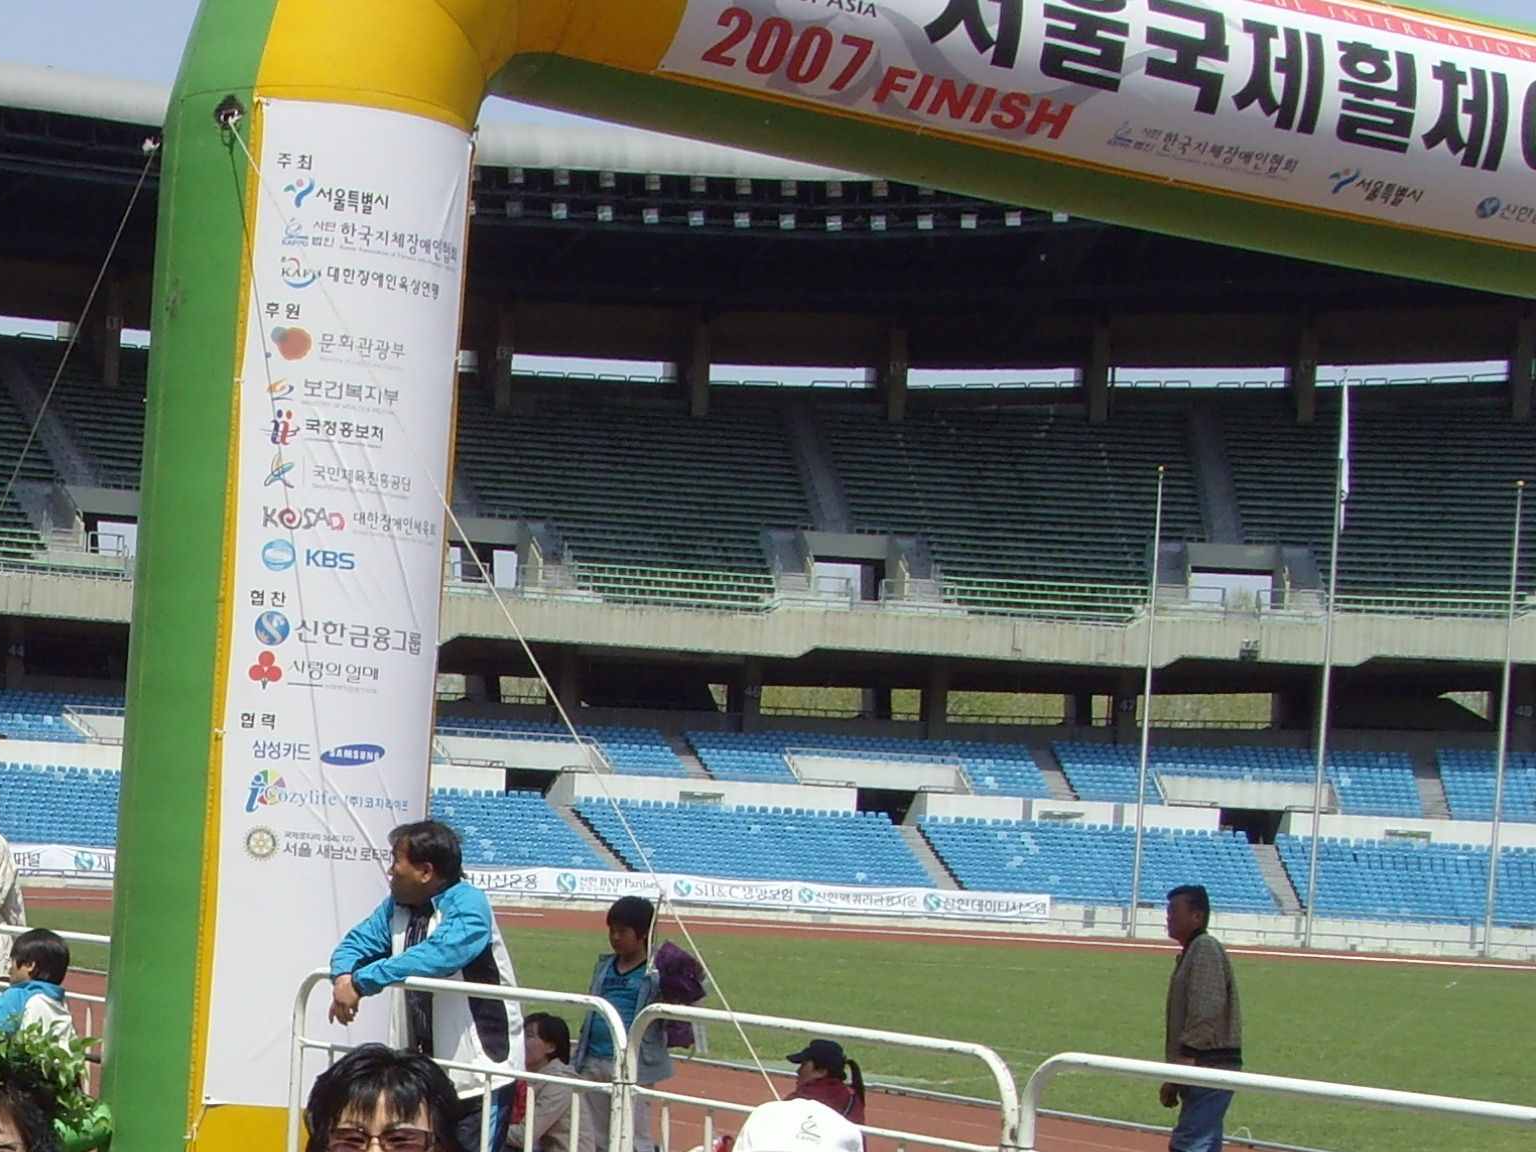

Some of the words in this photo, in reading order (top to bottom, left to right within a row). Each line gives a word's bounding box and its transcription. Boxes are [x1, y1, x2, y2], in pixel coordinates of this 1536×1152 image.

[701, 7, 874, 92] 2007
[873, 65, 1076, 141] FINISH
[315, 186, 390, 215] 서울특별시
[1355, 177, 1426, 208] 서울특별시
[317, 332, 406, 360] 문화관광부
[303, 378, 400, 407] 보건복지부
[305, 418, 384, 442] 국정홍보처
[312, 464, 412, 492] 국민체육진흥공단
[305, 549, 356, 570] KBS
[294, 618, 422, 656] 신한금융그룹
[251, 739, 312, 762] 삼성카드
[328, 748, 380, 762] SAMSUNG
[283, 841, 313, 858] 서울
